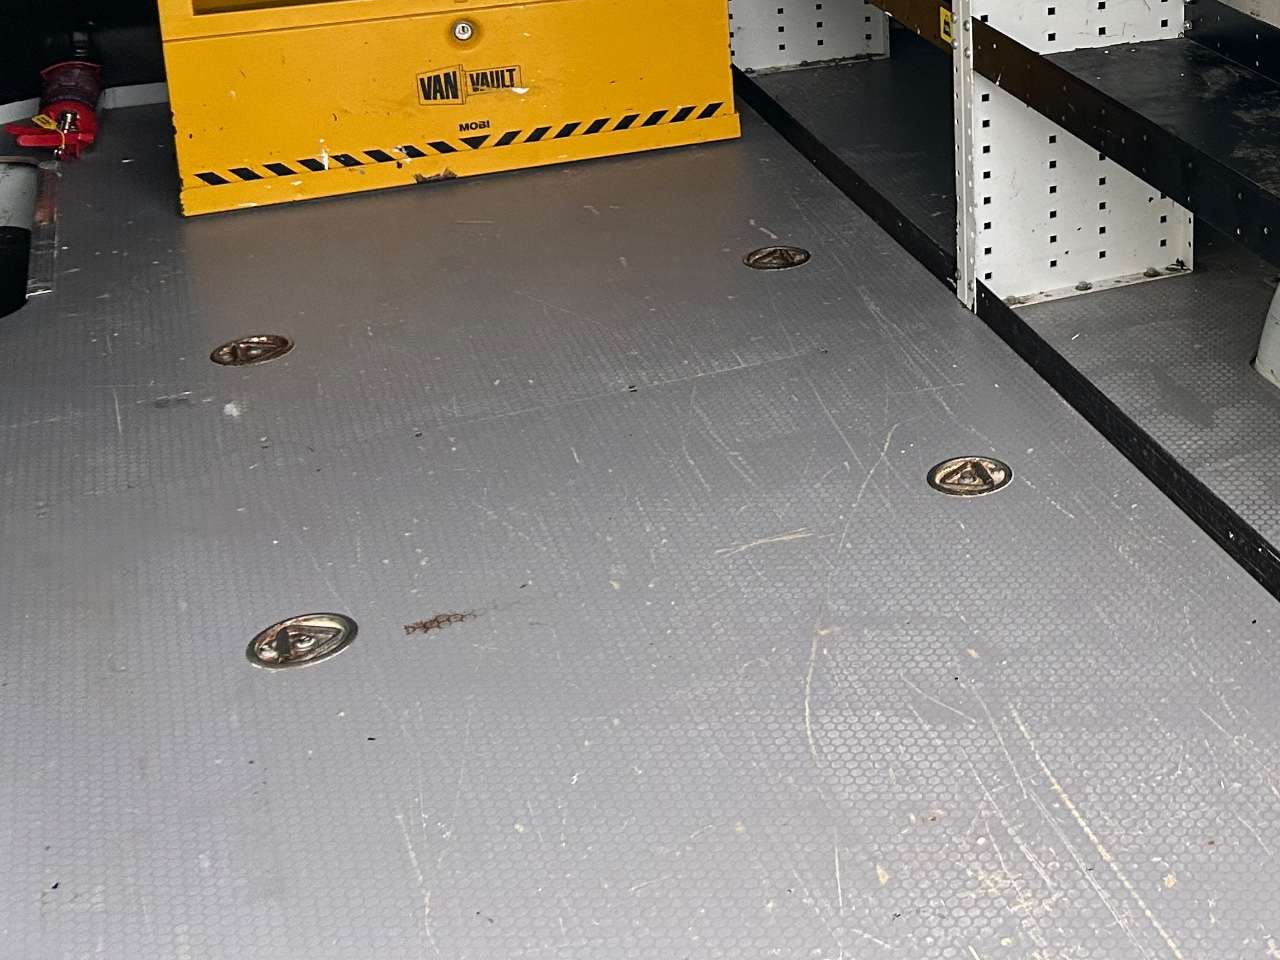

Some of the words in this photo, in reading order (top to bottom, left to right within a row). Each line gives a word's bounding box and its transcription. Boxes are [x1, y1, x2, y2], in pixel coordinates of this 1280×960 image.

[418, 70, 460, 101] VAN
[468, 67, 517, 93] VAULT
[458, 119, 491, 133] MOBI
